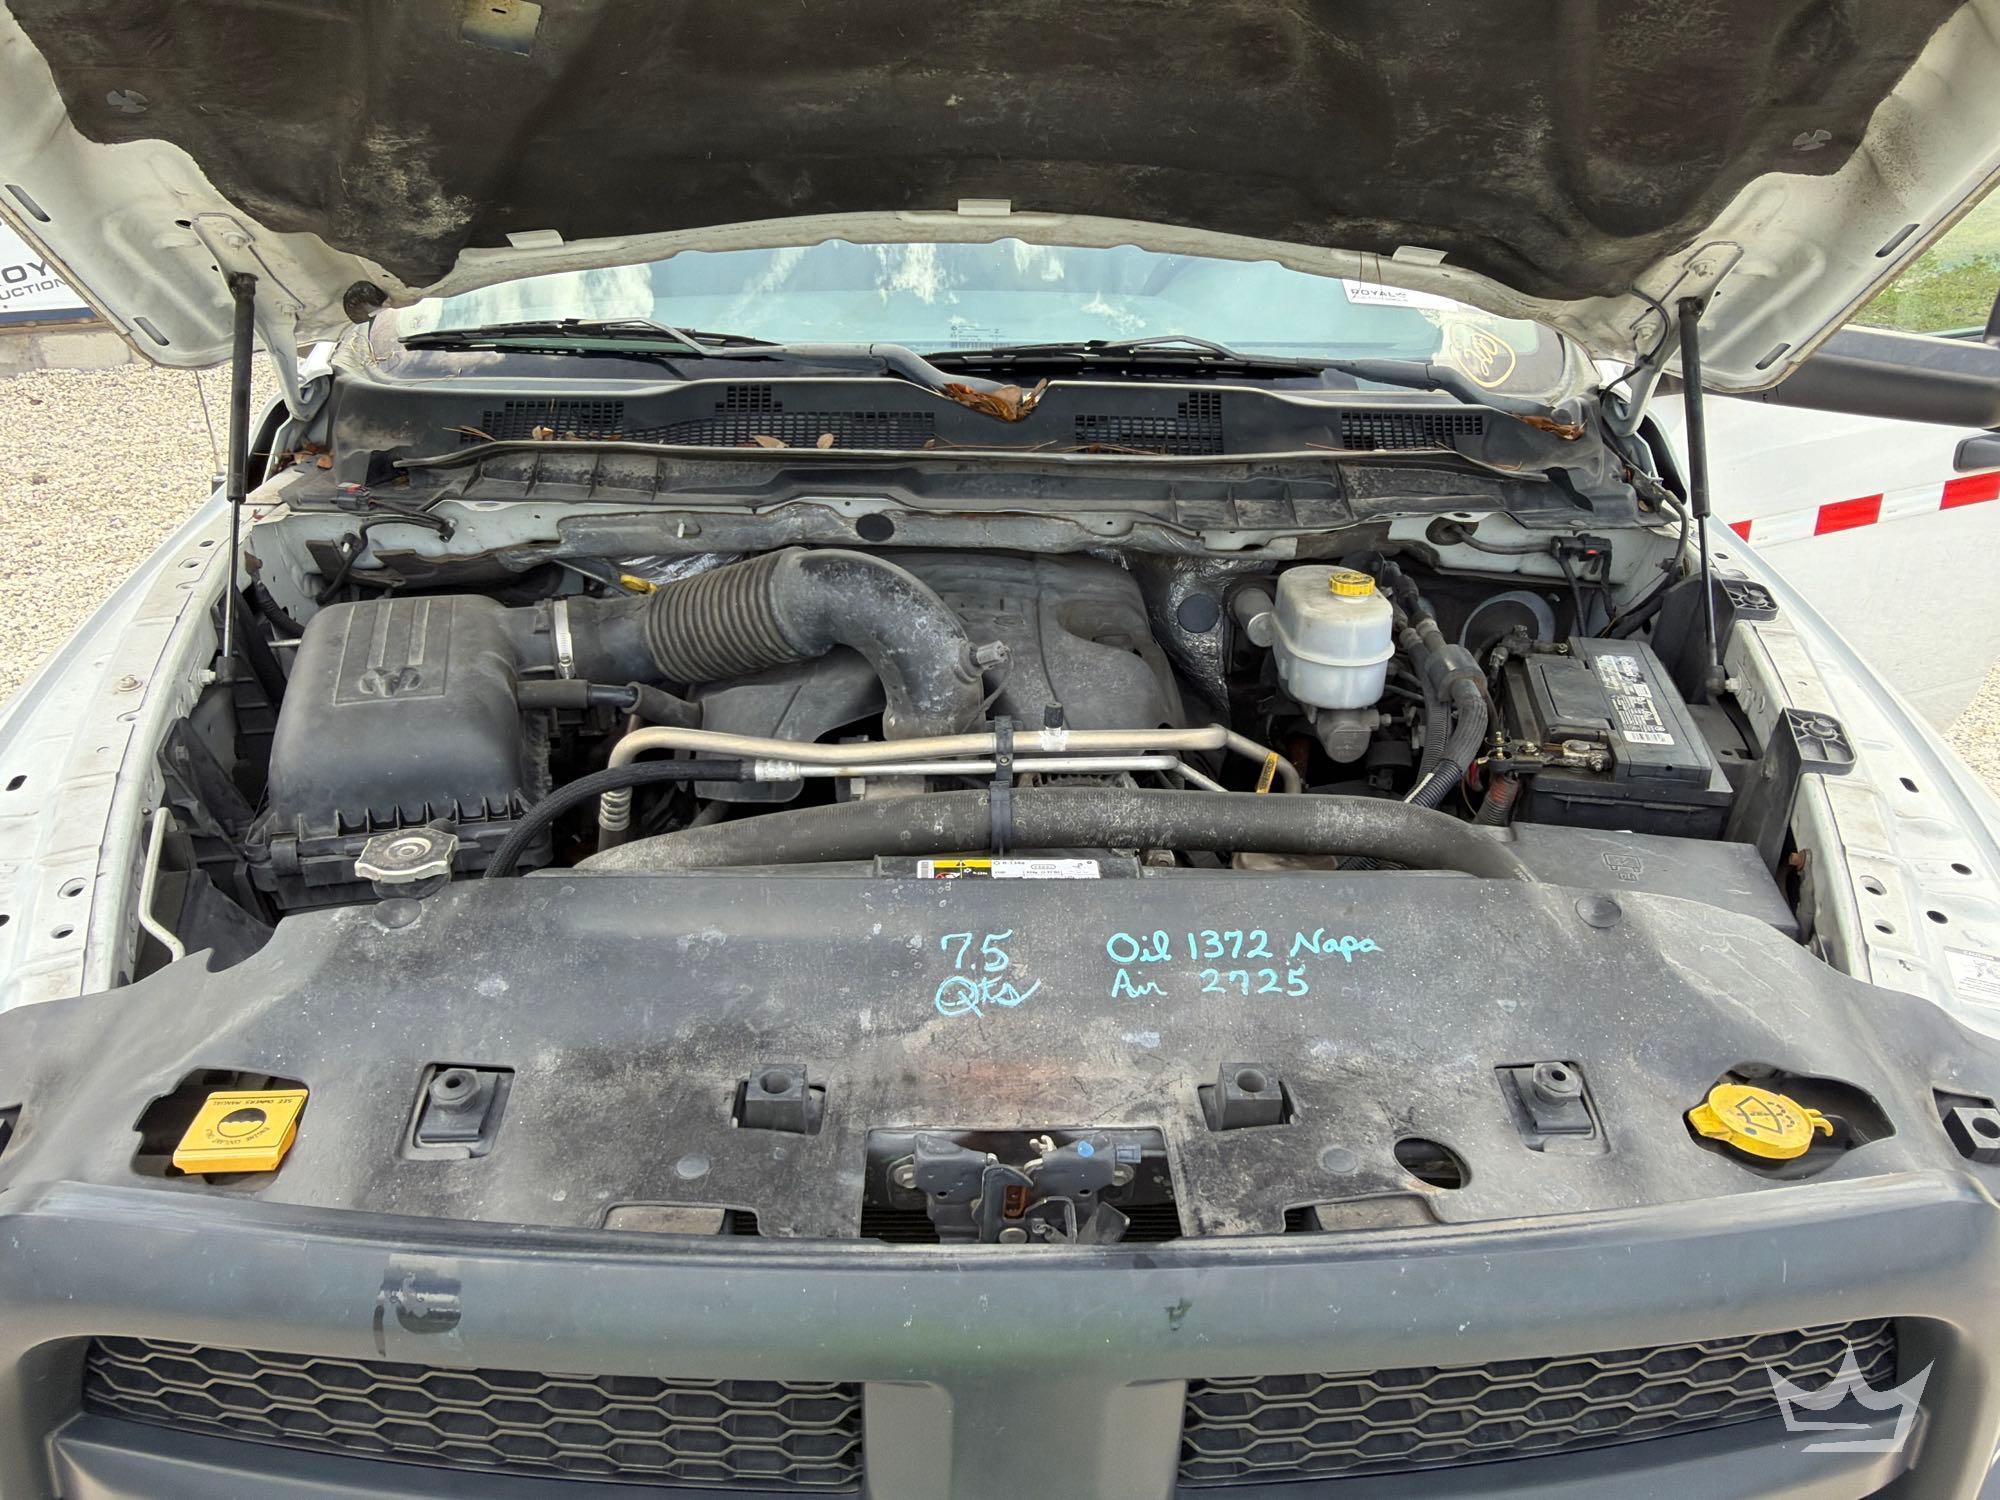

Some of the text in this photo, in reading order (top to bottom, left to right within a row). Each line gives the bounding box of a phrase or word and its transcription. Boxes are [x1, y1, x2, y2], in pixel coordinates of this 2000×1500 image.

[0, 259, 48, 287] OY
[940, 929, 1013, 973] 7.5
[1106, 927, 1384, 963] Oil 1372 Napa
[1200, 964, 1309, 997] 2725
